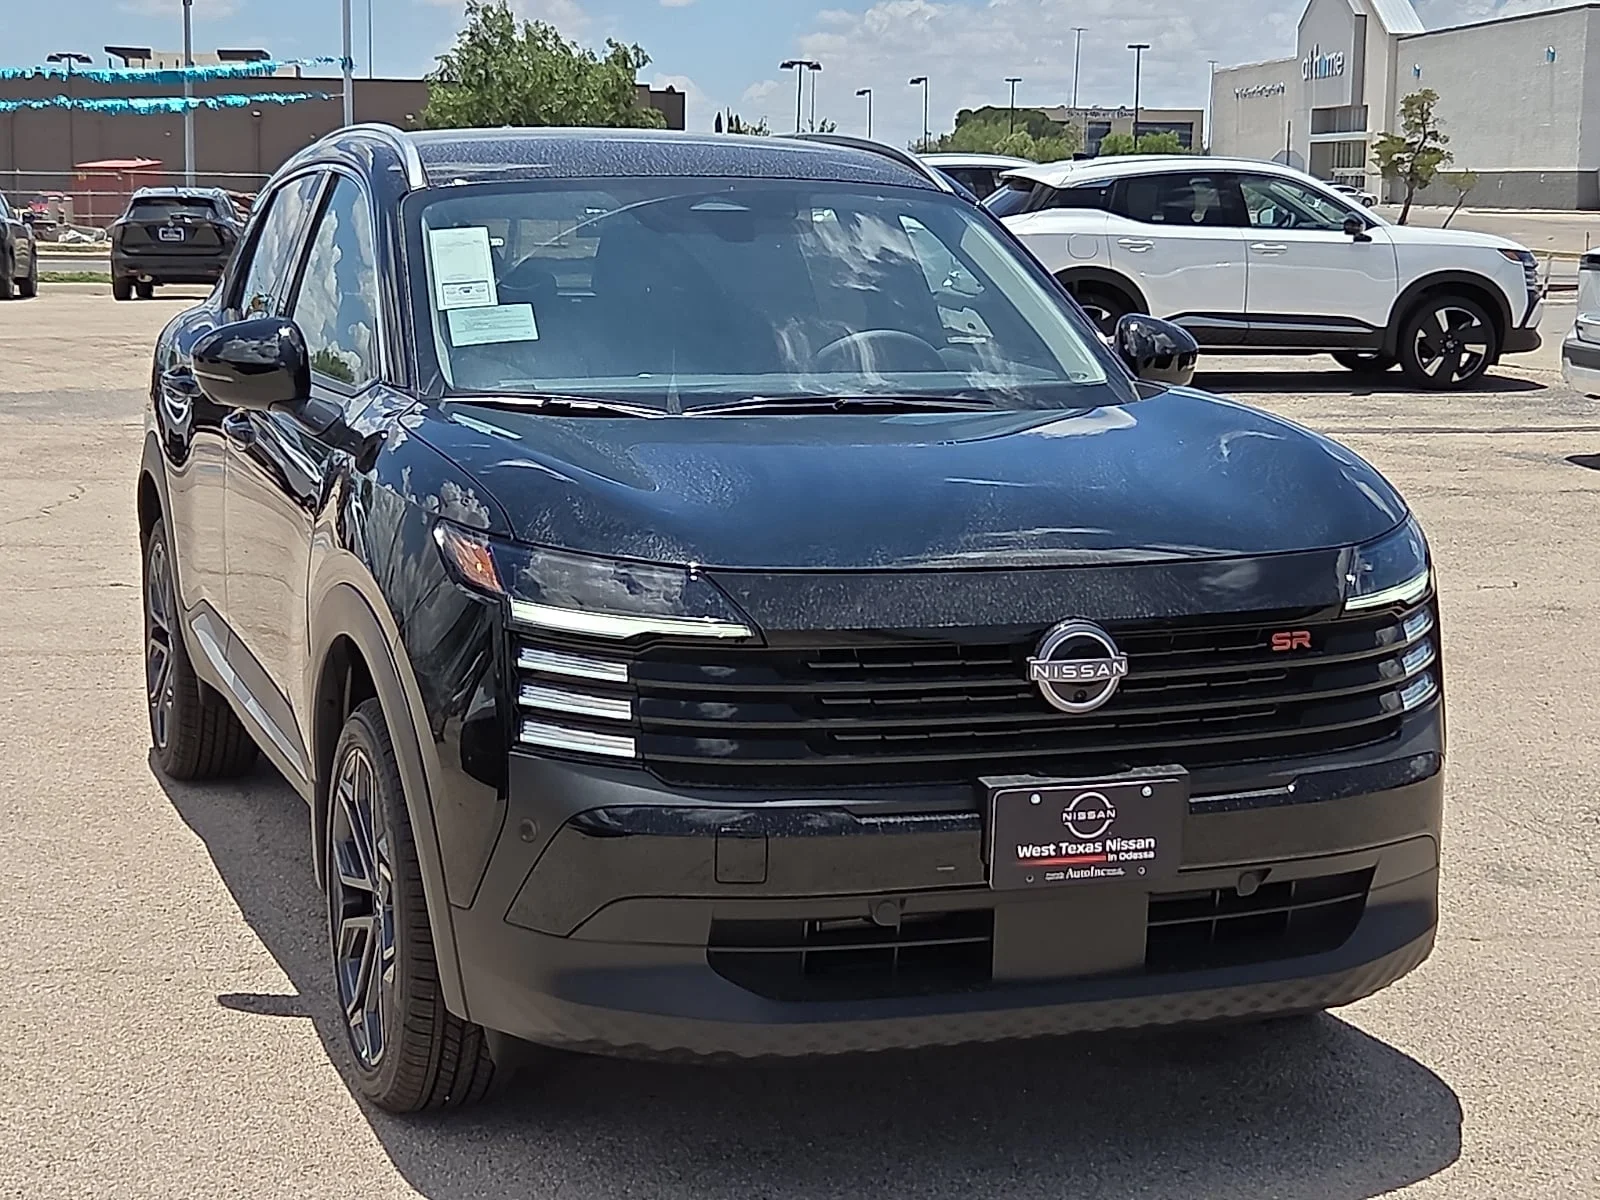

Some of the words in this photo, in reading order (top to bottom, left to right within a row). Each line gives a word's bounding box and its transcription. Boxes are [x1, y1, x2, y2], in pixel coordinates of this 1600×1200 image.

[1271, 630, 1312, 650] SR
[1032, 660, 1127, 680] NISSAN
[1062, 809, 1116, 822] NISSAN
[1017, 843, 1057, 858] West
[1059, 841, 1103, 855] Texas
[1105, 837, 1156, 852] Nissan
[1118, 850, 1155, 861] Odessa
